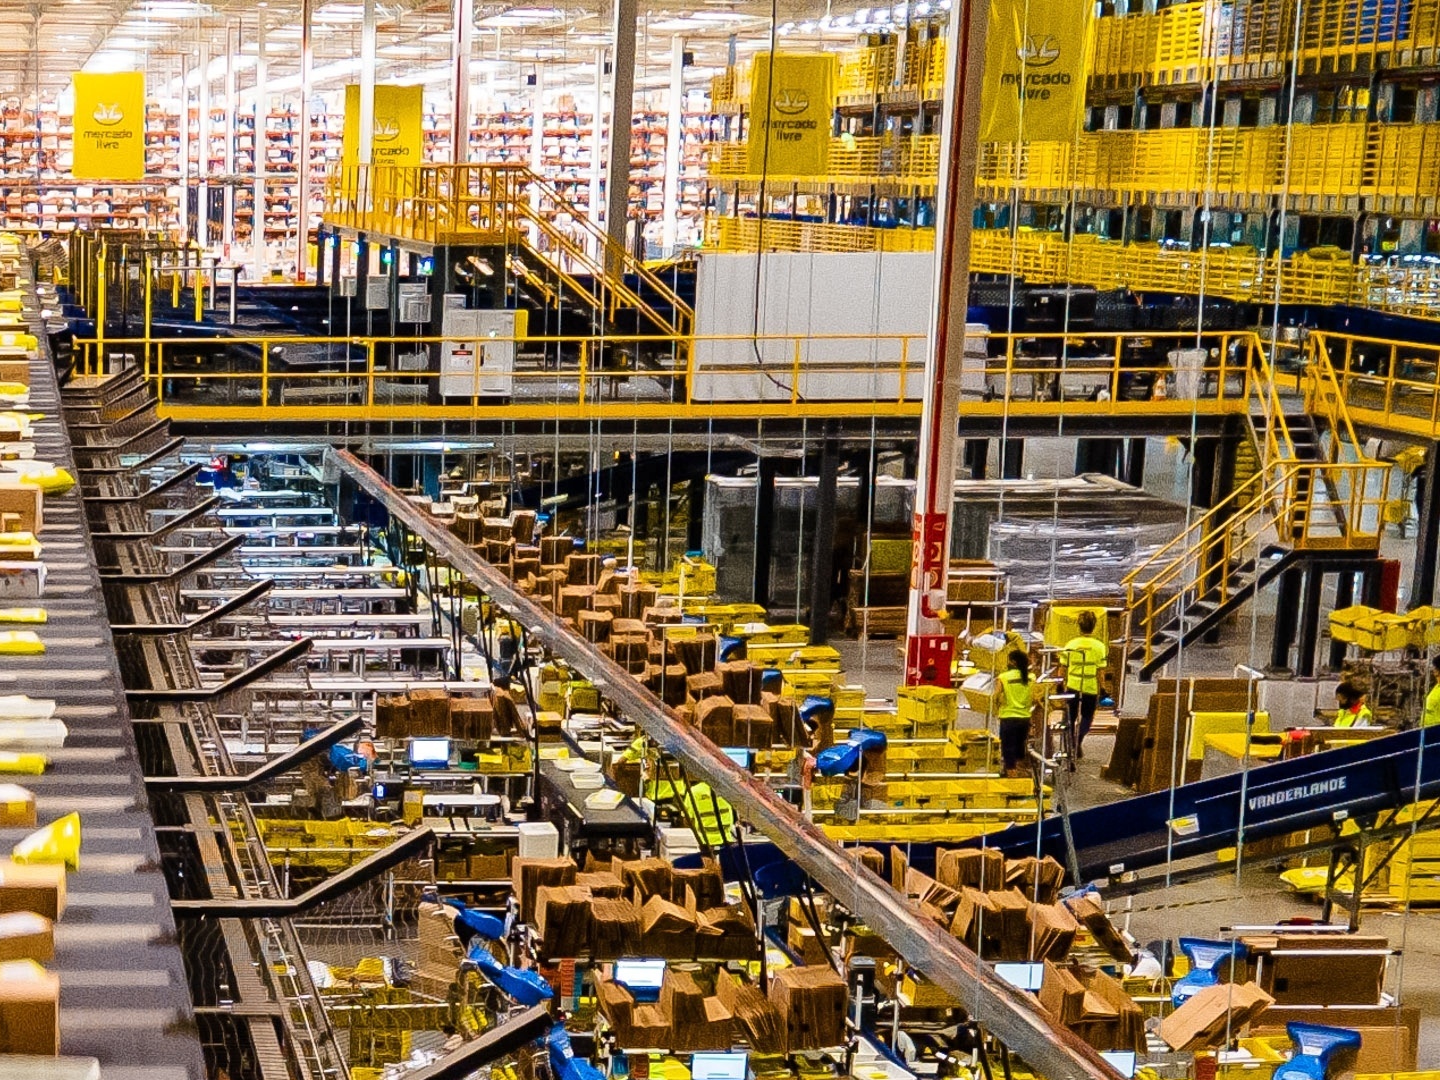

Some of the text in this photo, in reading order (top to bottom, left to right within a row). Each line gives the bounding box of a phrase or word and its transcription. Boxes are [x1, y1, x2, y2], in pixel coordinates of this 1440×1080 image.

[83, 129, 133, 139] mercado
[96, 139, 119, 149] livre
[1248, 776, 1347, 811] VANDERLANDE
